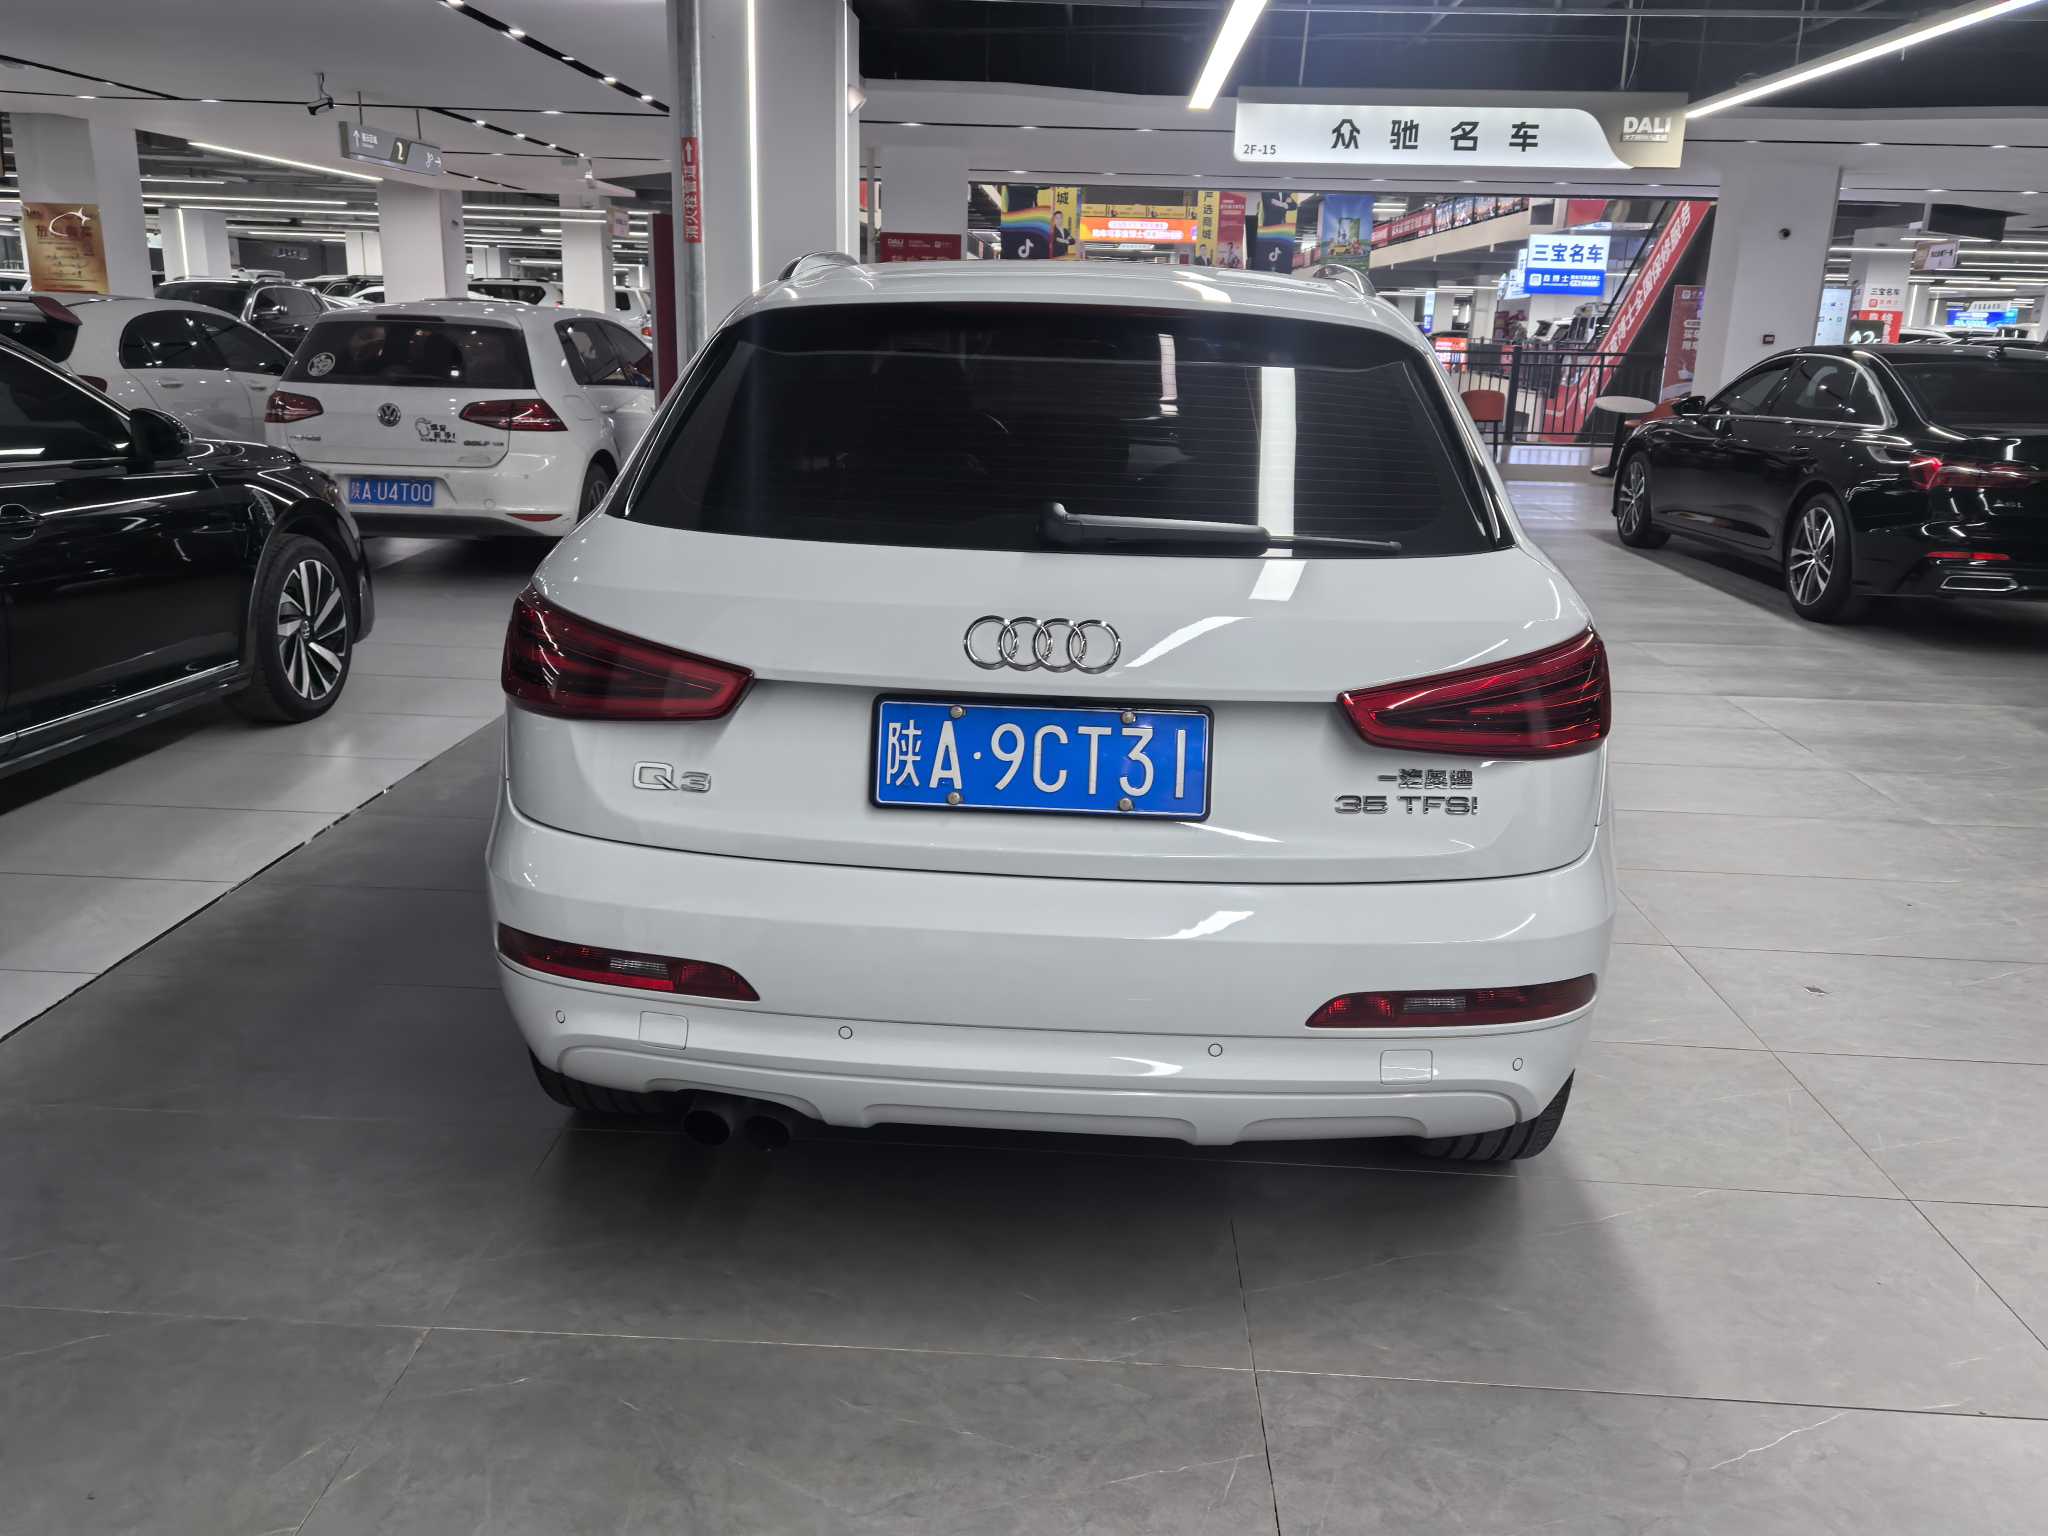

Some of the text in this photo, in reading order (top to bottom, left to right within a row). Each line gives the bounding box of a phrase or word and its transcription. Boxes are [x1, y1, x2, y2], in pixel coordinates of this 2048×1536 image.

[1331, 117, 1541, 153] 众驰名车
[1623, 116, 1672, 133] DALI
[1242, 144, 1278, 157] 2F-15
[1531, 243, 1605, 264] 三宝名车
[886, 719, 1186, 799] 陕A·9CT31
[633, 761, 712, 793] Q3
[1334, 795, 1479, 816] 35 TFSI
